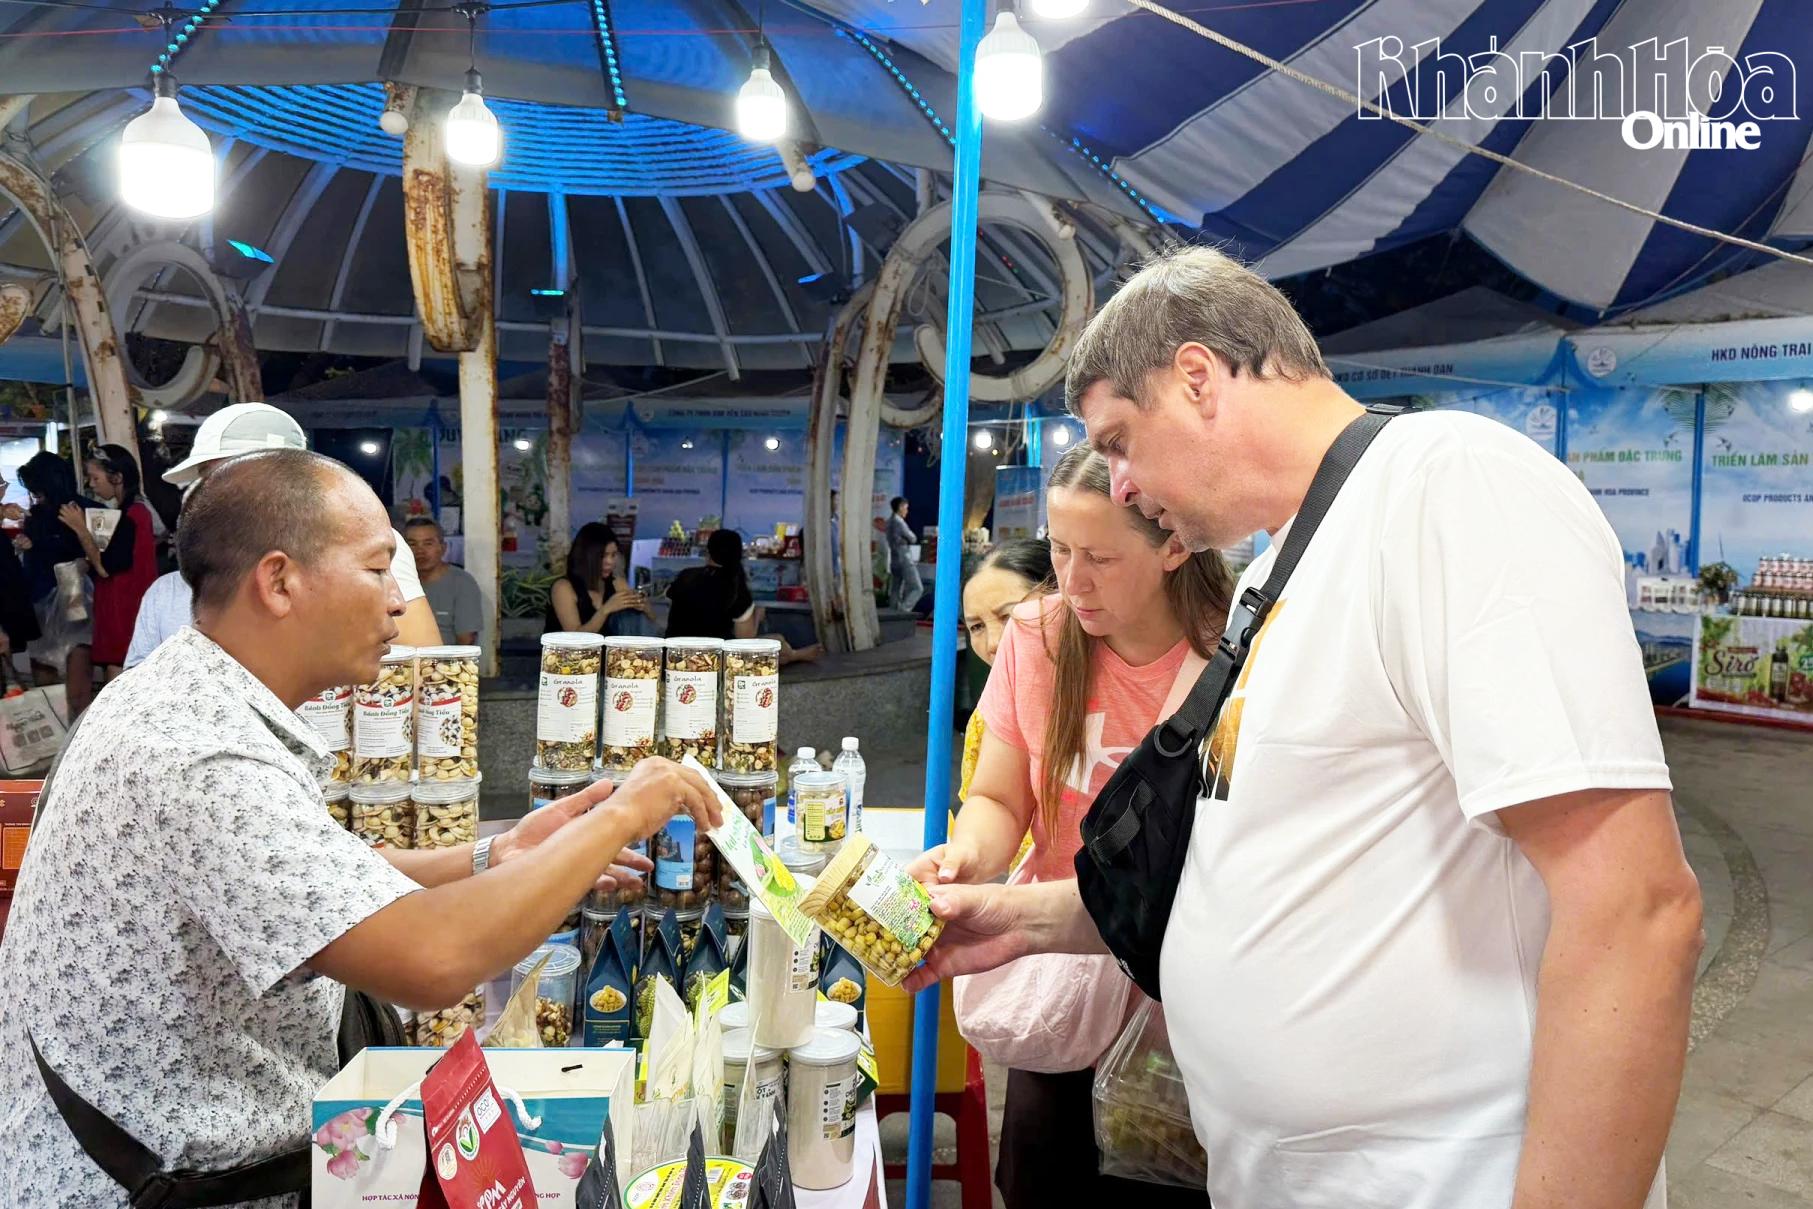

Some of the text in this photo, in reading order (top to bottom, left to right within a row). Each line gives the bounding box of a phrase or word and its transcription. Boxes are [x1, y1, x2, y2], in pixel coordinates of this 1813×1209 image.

[1711, 347, 1737, 361] HKD
[1741, 344, 1777, 360] NÔNG
[404, 1193, 419, 1201] NÔN
